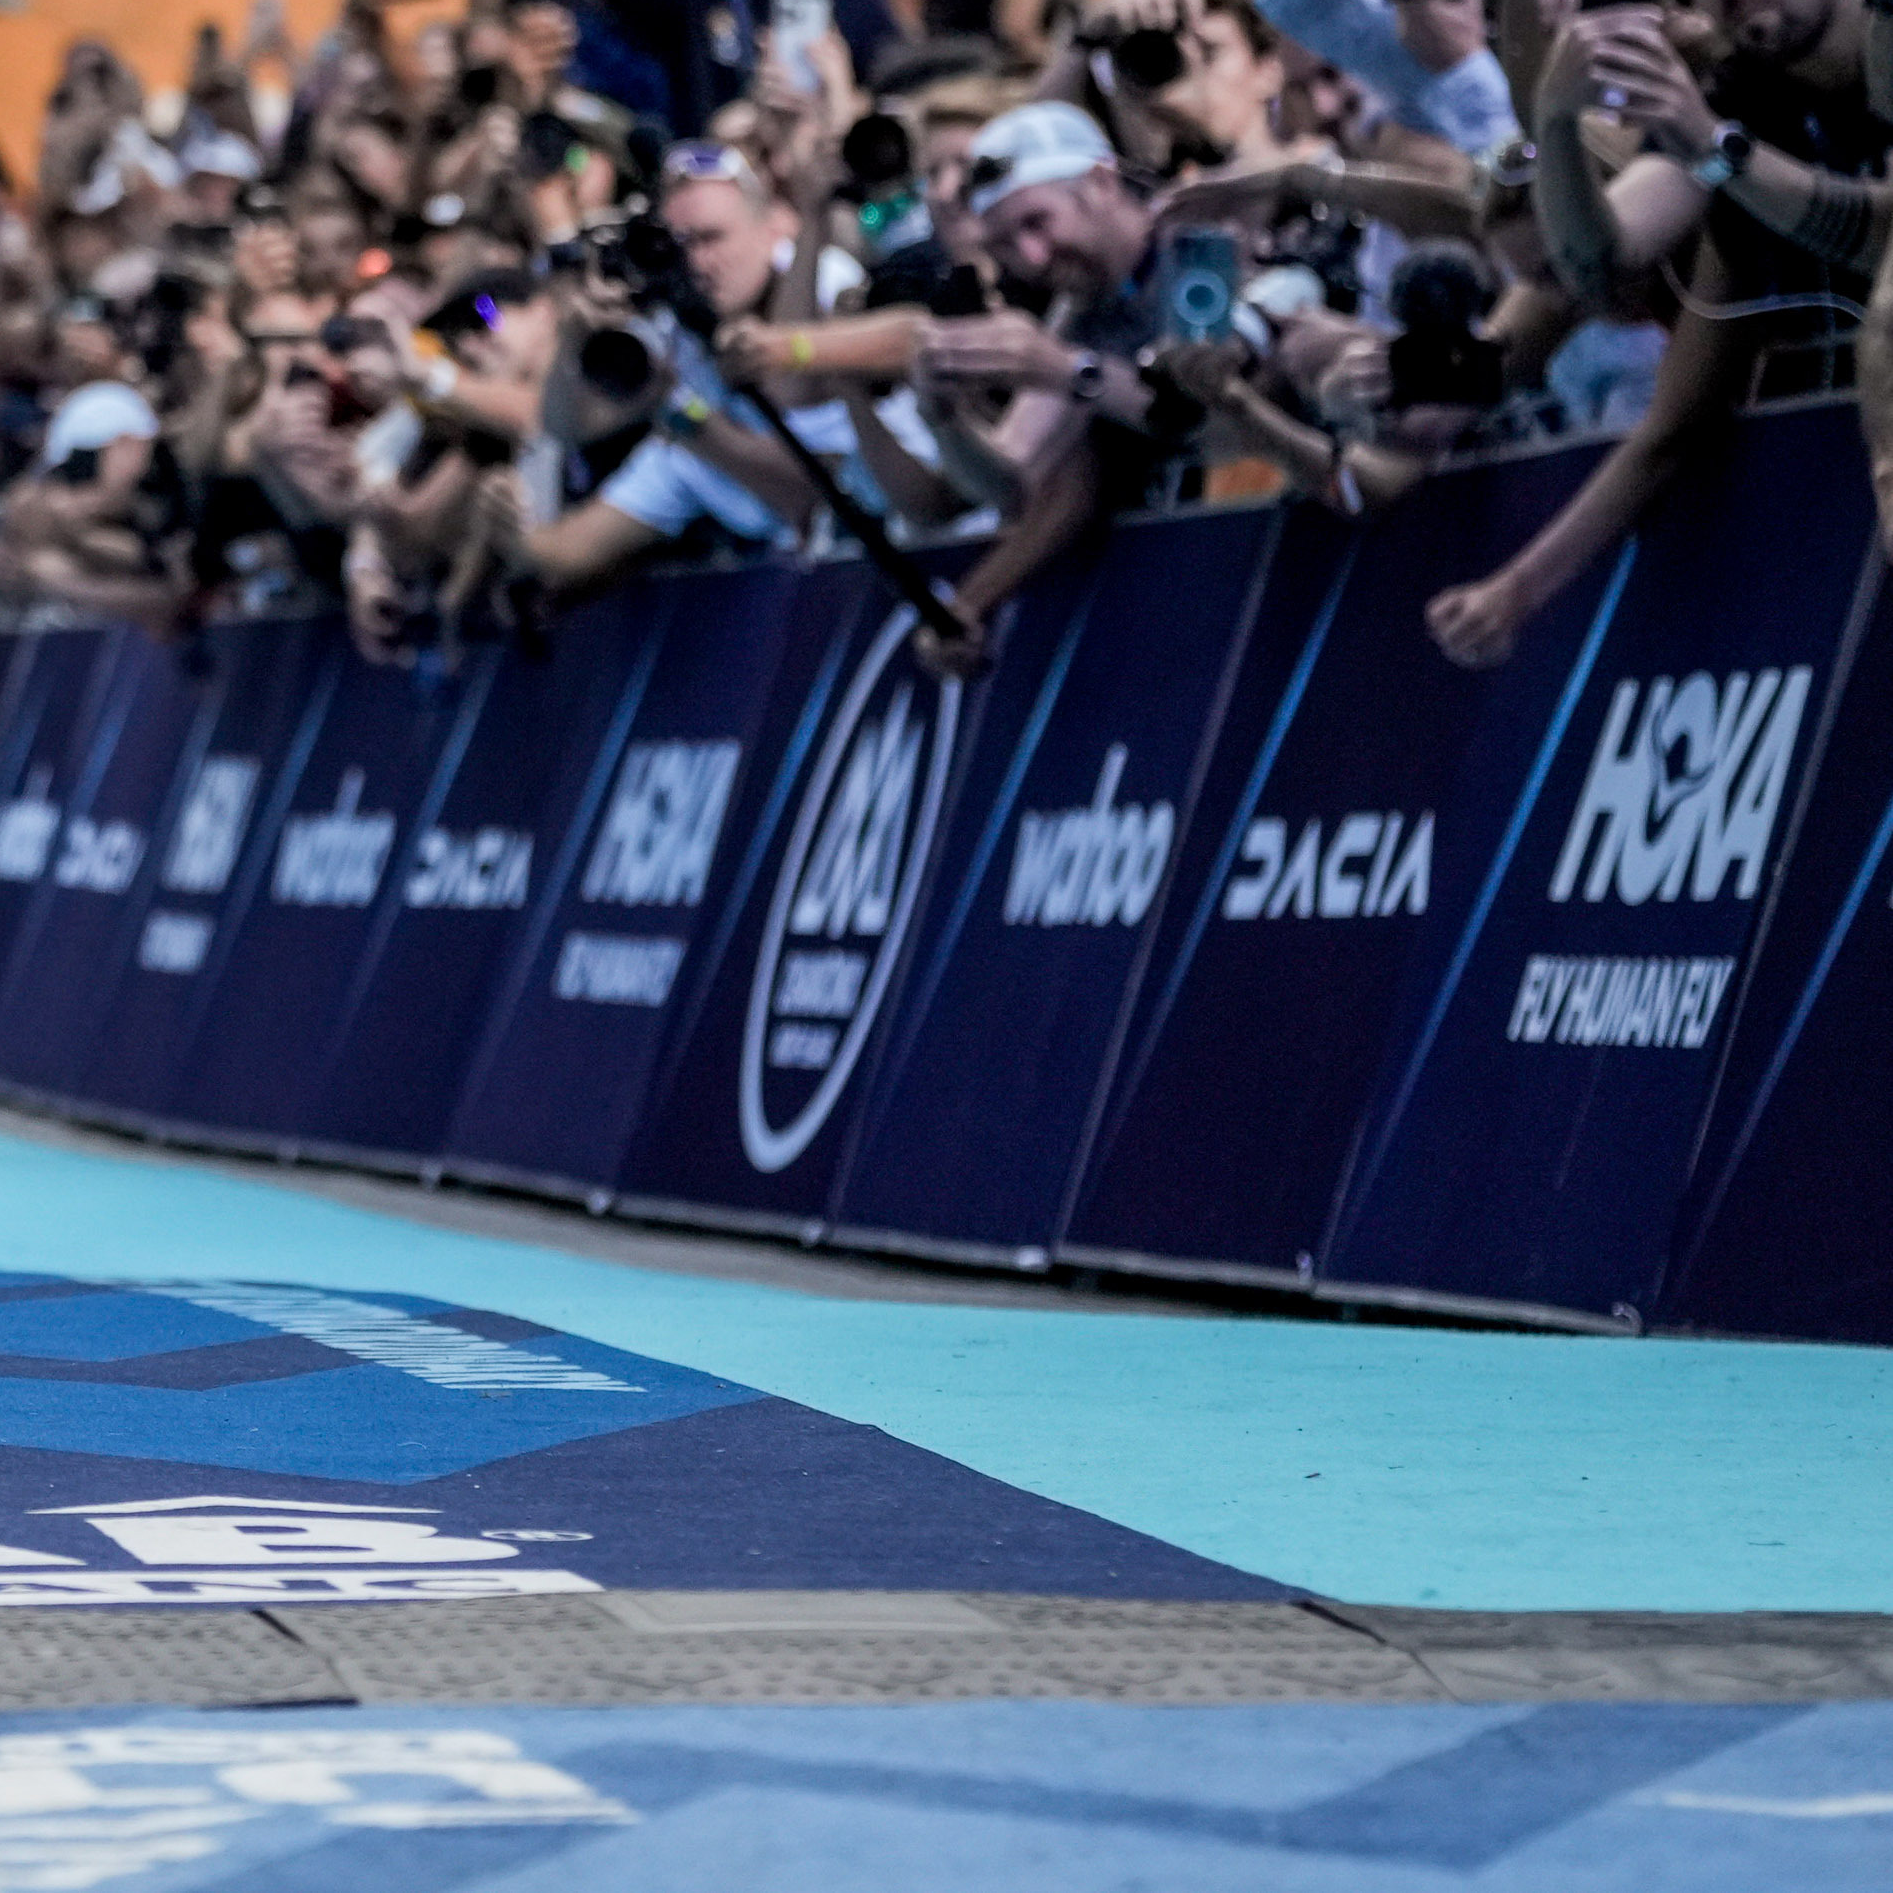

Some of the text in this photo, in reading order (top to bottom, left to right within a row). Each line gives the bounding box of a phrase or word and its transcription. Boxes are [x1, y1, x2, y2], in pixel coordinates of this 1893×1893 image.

[1003, 741, 1176, 930] wahoo
[1549, 665, 1812, 906] HOKA
[1221, 810, 1436, 921] DACIA
[1506, 955, 1736, 1049] FLY HUMAN FLY
